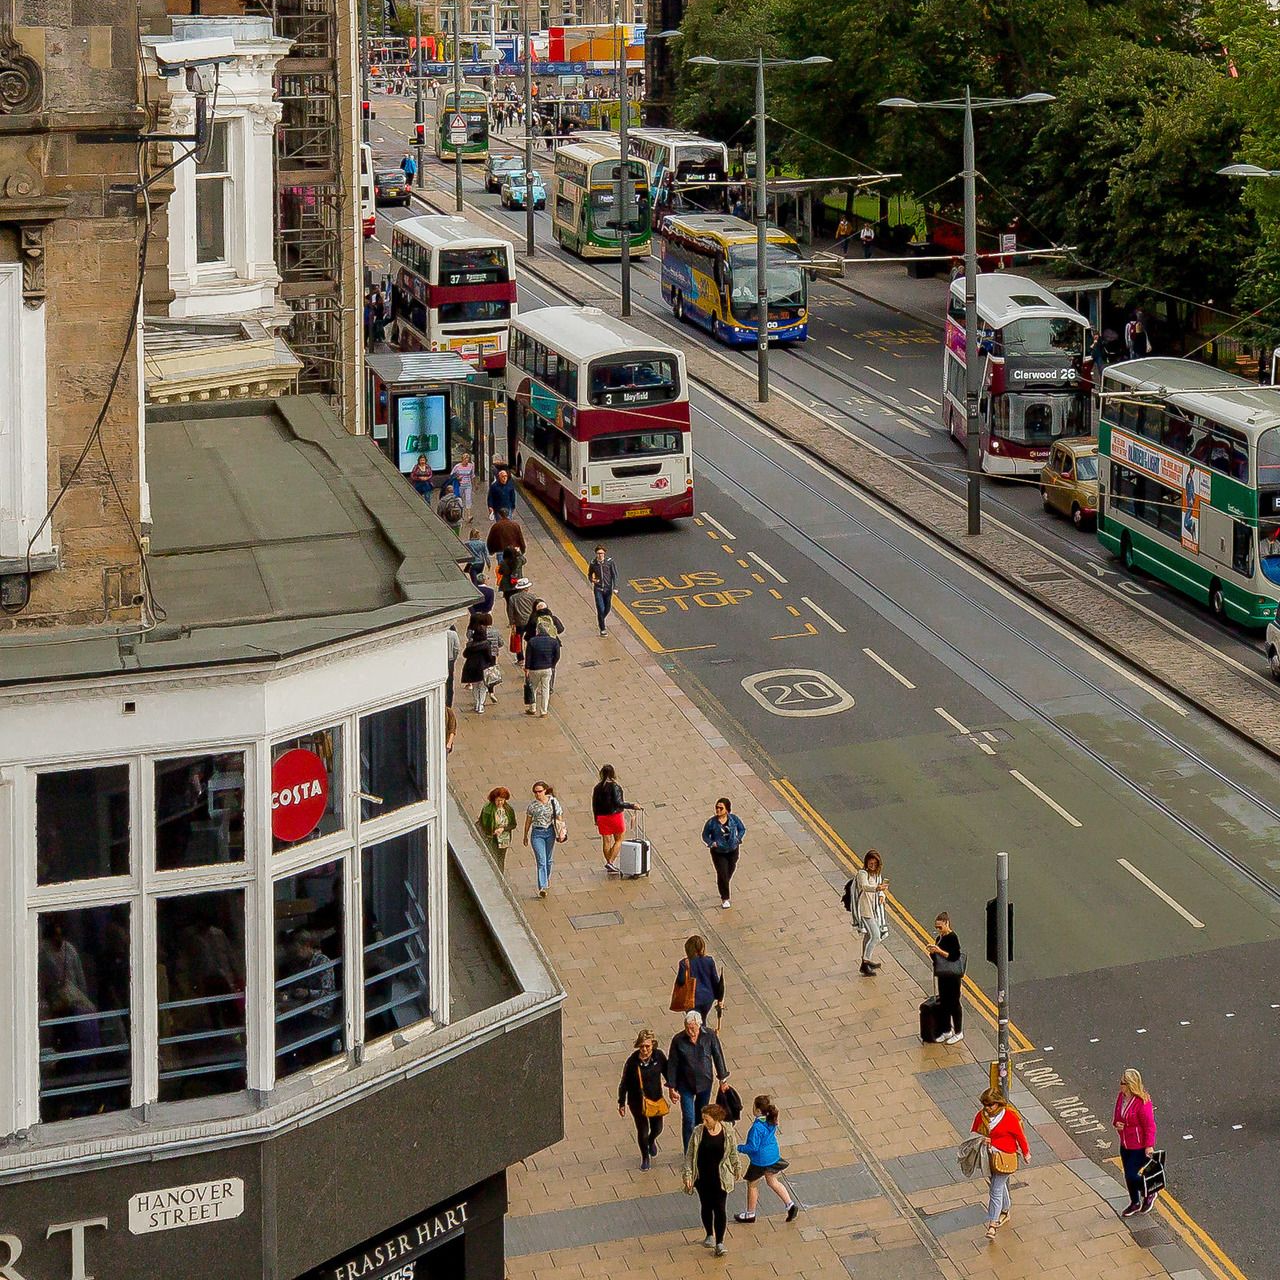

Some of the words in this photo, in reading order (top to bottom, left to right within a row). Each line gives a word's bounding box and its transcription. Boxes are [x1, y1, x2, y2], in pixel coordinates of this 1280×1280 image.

[450, 275, 460, 284] 37
[1014, 370, 1057, 380] Clerwood
[1060, 369, 1076, 380] 26
[606, 394, 612, 405] 3
[628, 571, 726, 594] BUS
[631, 590, 754, 615] STOP
[761, 680, 835, 705] 20
[271, 779, 322, 810] COSTA
[137, 1182, 234, 1213] HANOVER
[150, 1201, 224, 1228] STREET
[335, 1234, 413, 1280] FRASER
[416, 1202, 469, 1245] HART
